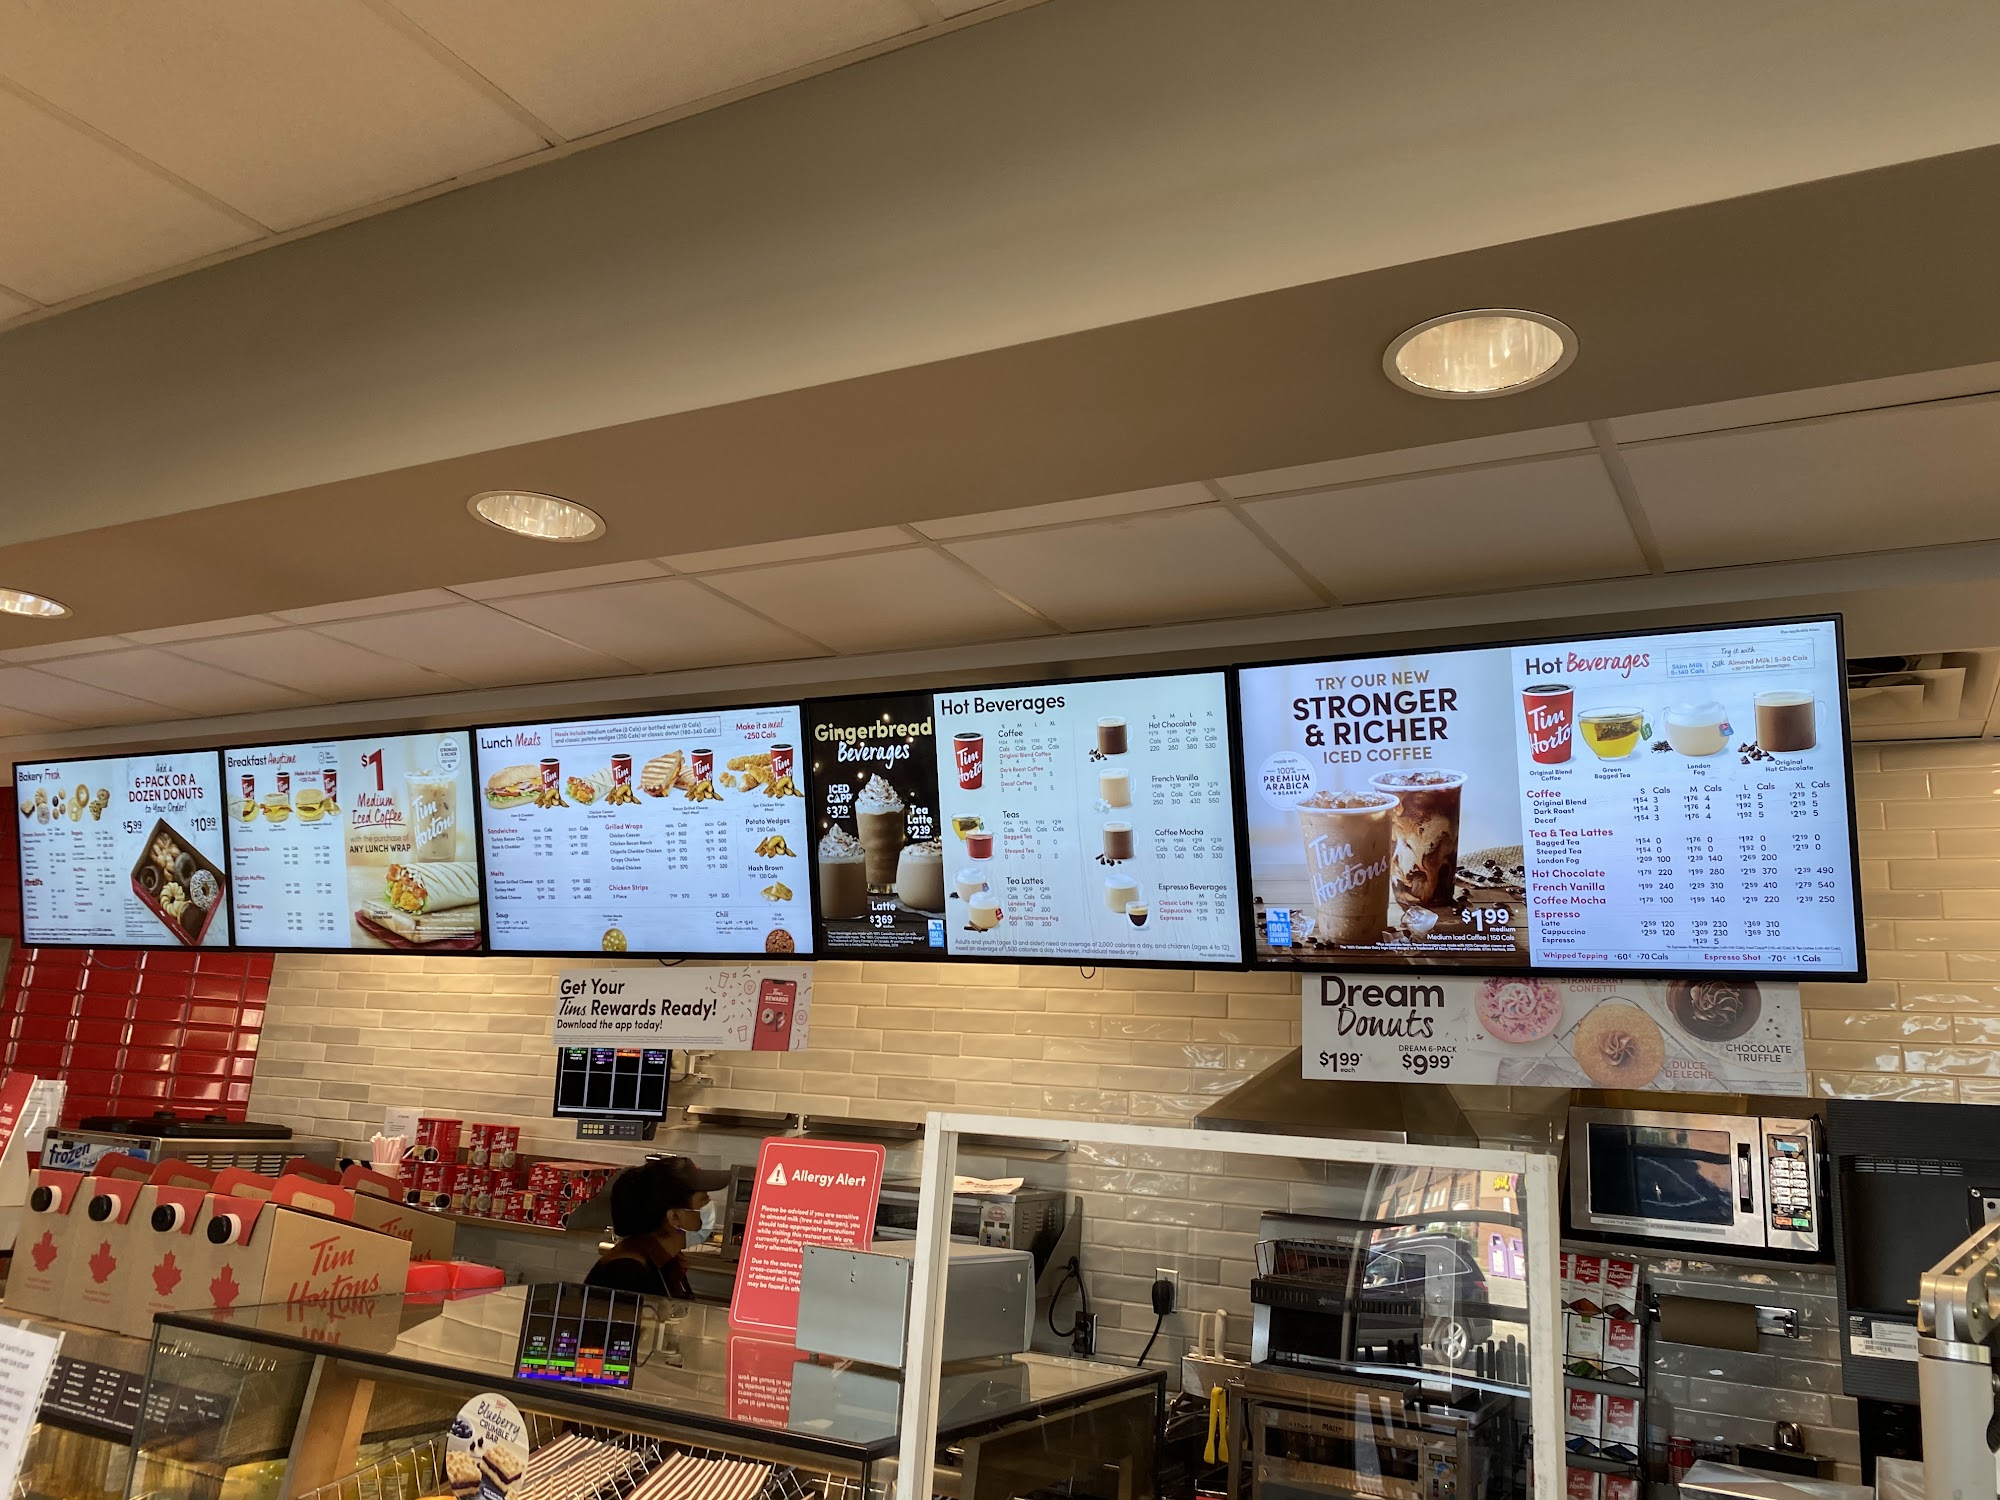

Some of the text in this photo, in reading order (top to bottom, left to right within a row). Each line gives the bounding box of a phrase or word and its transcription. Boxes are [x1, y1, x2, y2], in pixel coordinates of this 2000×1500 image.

[1525, 652, 1649, 678] Hot Beverages
[1315, 670, 1429, 690] TRY OUR NEW
[942, 696, 1065, 715] Hot Beverages
[1293, 688, 1457, 720] STRONGER
[1528, 704, 1565, 732] Tim
[744, 731, 776, 740] +250 Cals
[815, 716, 932, 745] Gingerbread
[1305, 717, 1448, 746] & RICHER
[481, 732, 541, 749] Lunch Meals
[838, 741, 910, 769] Beverages
[1324, 747, 1432, 764] ICED COFFEE
[228, 755, 266, 768] Breakfast
[268, 753, 296, 771] Anytime
[19, 772, 42, 782] Bakery
[135, 774, 196, 788] 6-PACK OR A
[1264, 773, 1310, 783] PREMIUM
[829, 784, 850, 794] ICED
[1265, 782, 1309, 790] ARABICA
[129, 788, 203, 802] DOZEN DONUTS
[357, 793, 394, 807] Medium
[827, 794, 852, 803] CAPP
[1527, 790, 1561, 798] Coffee
[412, 795, 438, 822] Tim
[827, 806, 848, 818] $379
[910, 805, 928, 815] Tea
[352, 809, 402, 829] Iced Coffee
[907, 815, 932, 824] Latte
[907, 826, 930, 838] $239
[1529, 830, 1547, 838] Tea
[1581, 829, 1613, 837] Lattes
[390, 844, 410, 852] WRAP
[1309, 834, 1354, 869] Tim
[1566, 857, 1579, 865] Fog
[1552, 869, 1605, 878] Chocolate
[1313, 856, 1389, 906] Hortons
[1533, 883, 1605, 891] French Vanilla
[1190, 884, 1227, 892] Beverages
[872, 902, 896, 911] Latte
[1534, 896, 1568, 905] Coffee
[1534, 910, 1580, 920] Espresso
[870, 915, 893, 928] $369
[1543, 952, 1608, 961] Whipped Topping
[561, 979, 624, 995] Get Your
[1321, 975, 1444, 1007] Dream
[1570, 985, 1616, 993] CONFETTI
[559, 996, 717, 1020] Tims Rewards Ready!
[557, 1020, 663, 1032] Download the app today!
[1338, 1003, 1433, 1038] Donuts
[1726, 1044, 1791, 1054] CHOCOLATE
[1737, 1053, 1781, 1063] TRUFFLE
[1672, 1061, 1706, 1070] DULCE
[1665, 1069, 1714, 1079] DE LECHE
[50, 1143, 90, 1165] frozen
[792, 1170, 866, 1188] Allergy Alert
[836, 1212, 859, 1220] sensitive
[310, 1236, 355, 1276] Tim
[1579, 1260, 1593, 1268] Tim
[1576, 1266, 1599, 1275] Hortons
[478, 1401, 520, 1442] Blueberry
[480, 1420, 509, 1440] CRUMBLE
[485, 1432, 498, 1443] BAR
